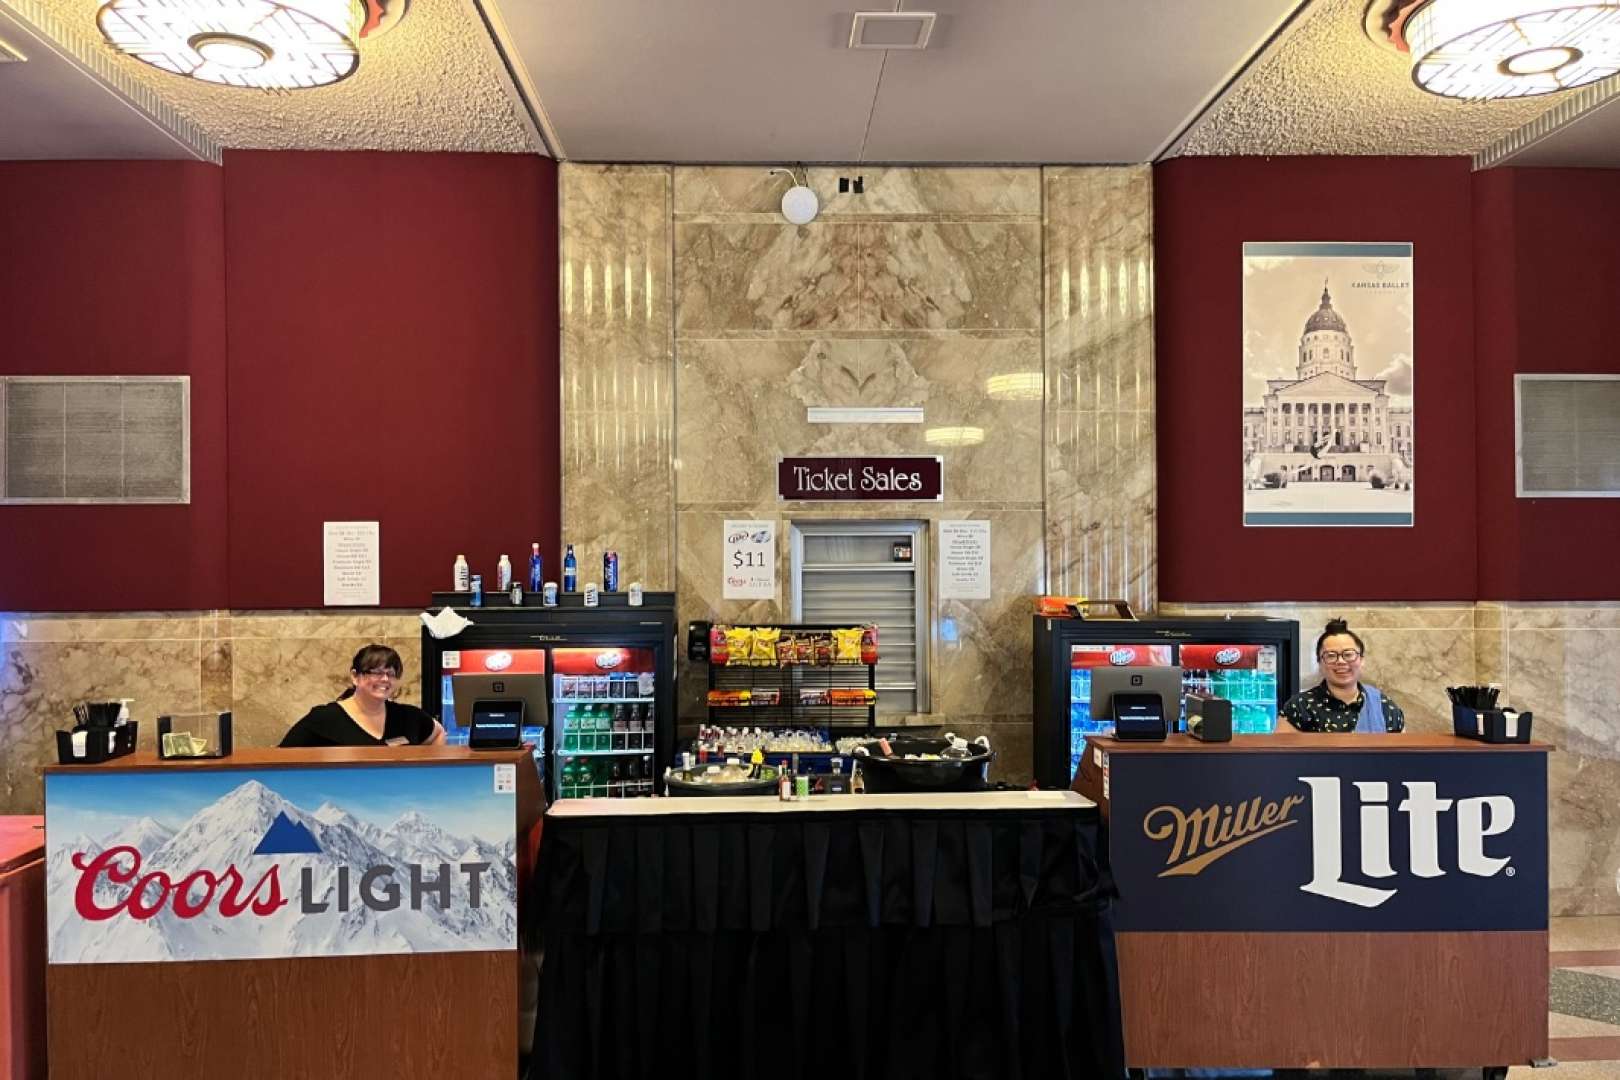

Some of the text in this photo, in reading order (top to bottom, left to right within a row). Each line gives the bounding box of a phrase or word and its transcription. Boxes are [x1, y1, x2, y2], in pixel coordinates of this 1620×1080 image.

[794, 466, 922, 491] Ticket Sales
[733, 549, 766, 569] $11
[1143, 776, 1515, 907] Miller Lite
[72, 845, 491, 920] Coors LIGHT
